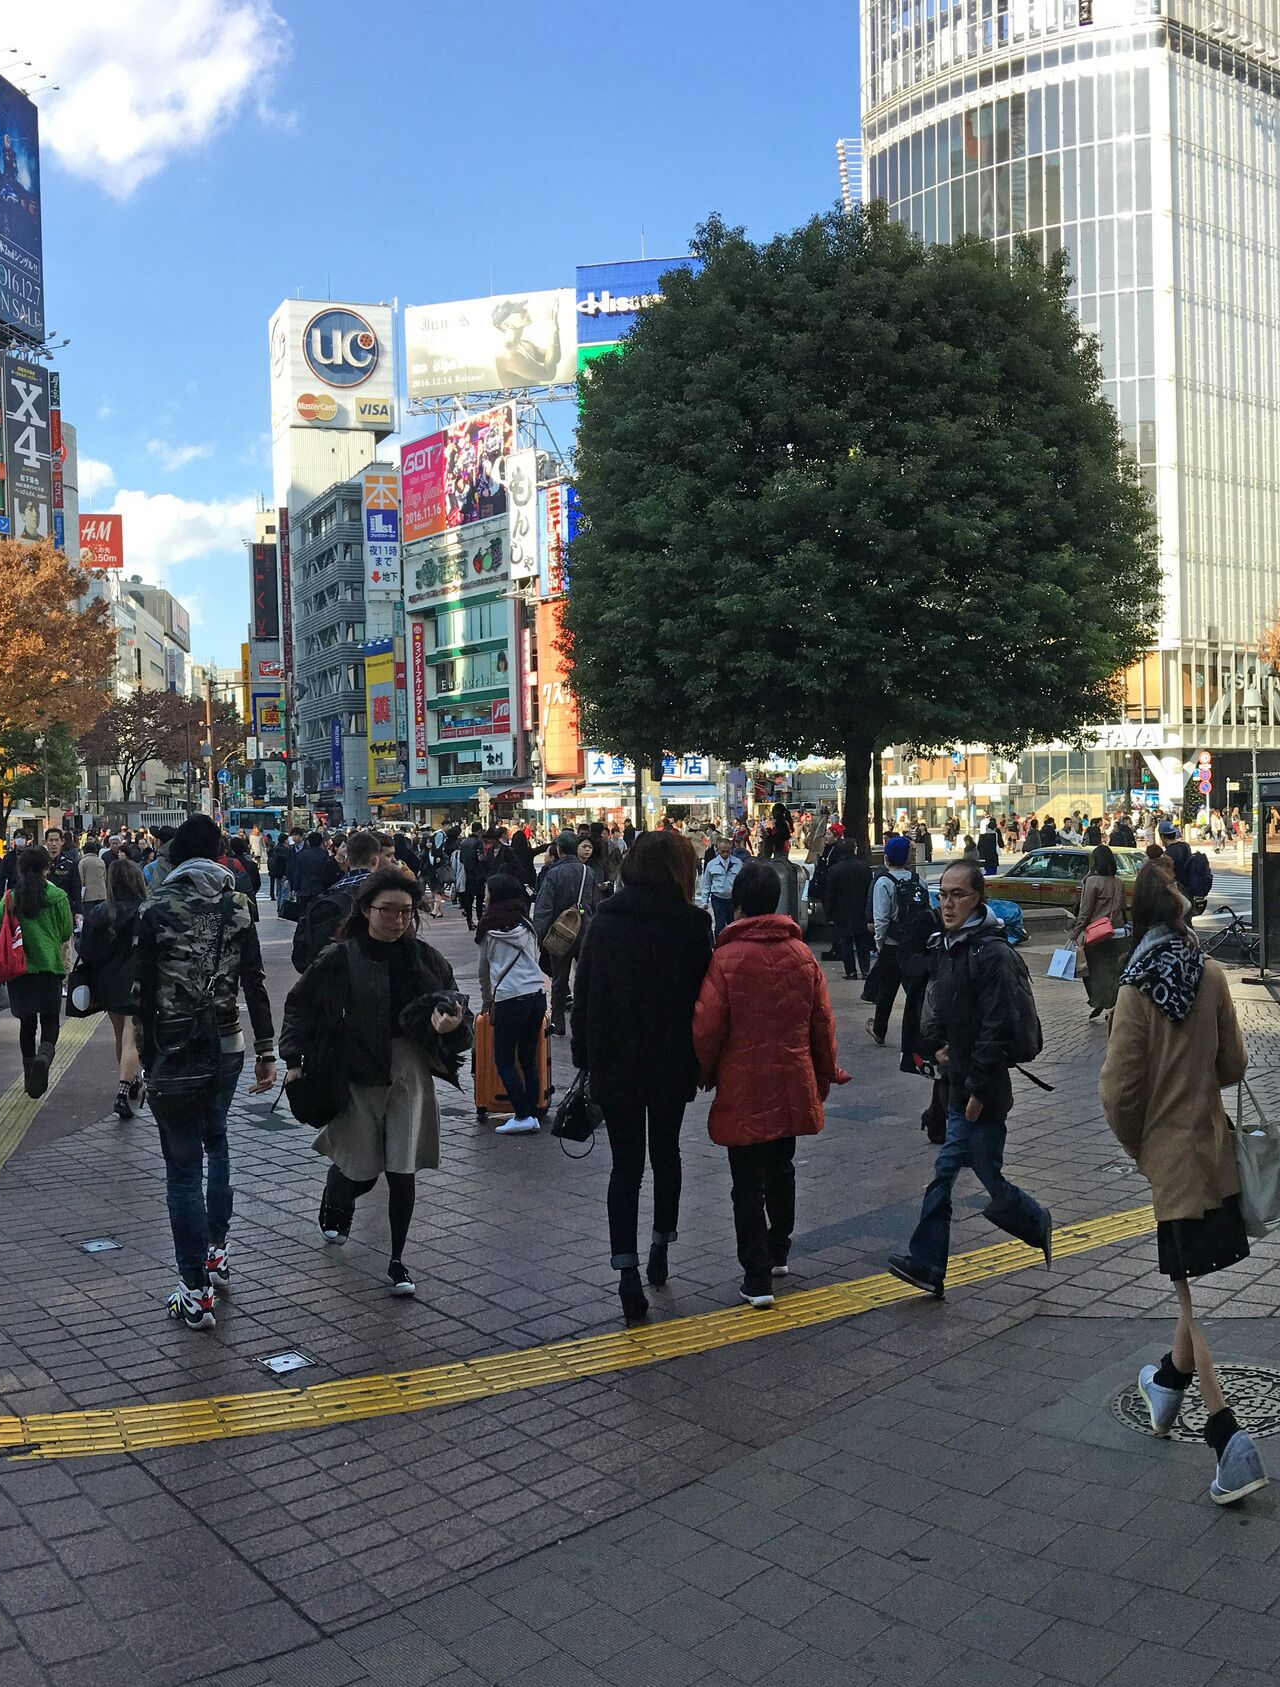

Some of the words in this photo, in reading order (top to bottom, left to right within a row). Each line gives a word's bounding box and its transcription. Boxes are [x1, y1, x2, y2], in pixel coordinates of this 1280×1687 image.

[411, 377, 452, 388] 2016.12.14
[297, 402, 336, 412] MasterCard
[359, 403, 389, 416] VISA
[403, 443, 442, 476] GOT7
[405, 504, 441, 525] 2016.11.16
[81, 520, 112, 542] H&M
[369, 546, 398, 556] 夜11時
[375, 557, 392, 567] まで
[382, 572, 398, 582] 地下
[494, 703, 510, 719] JTB
[593, 756, 703, 776] 大盛書店
